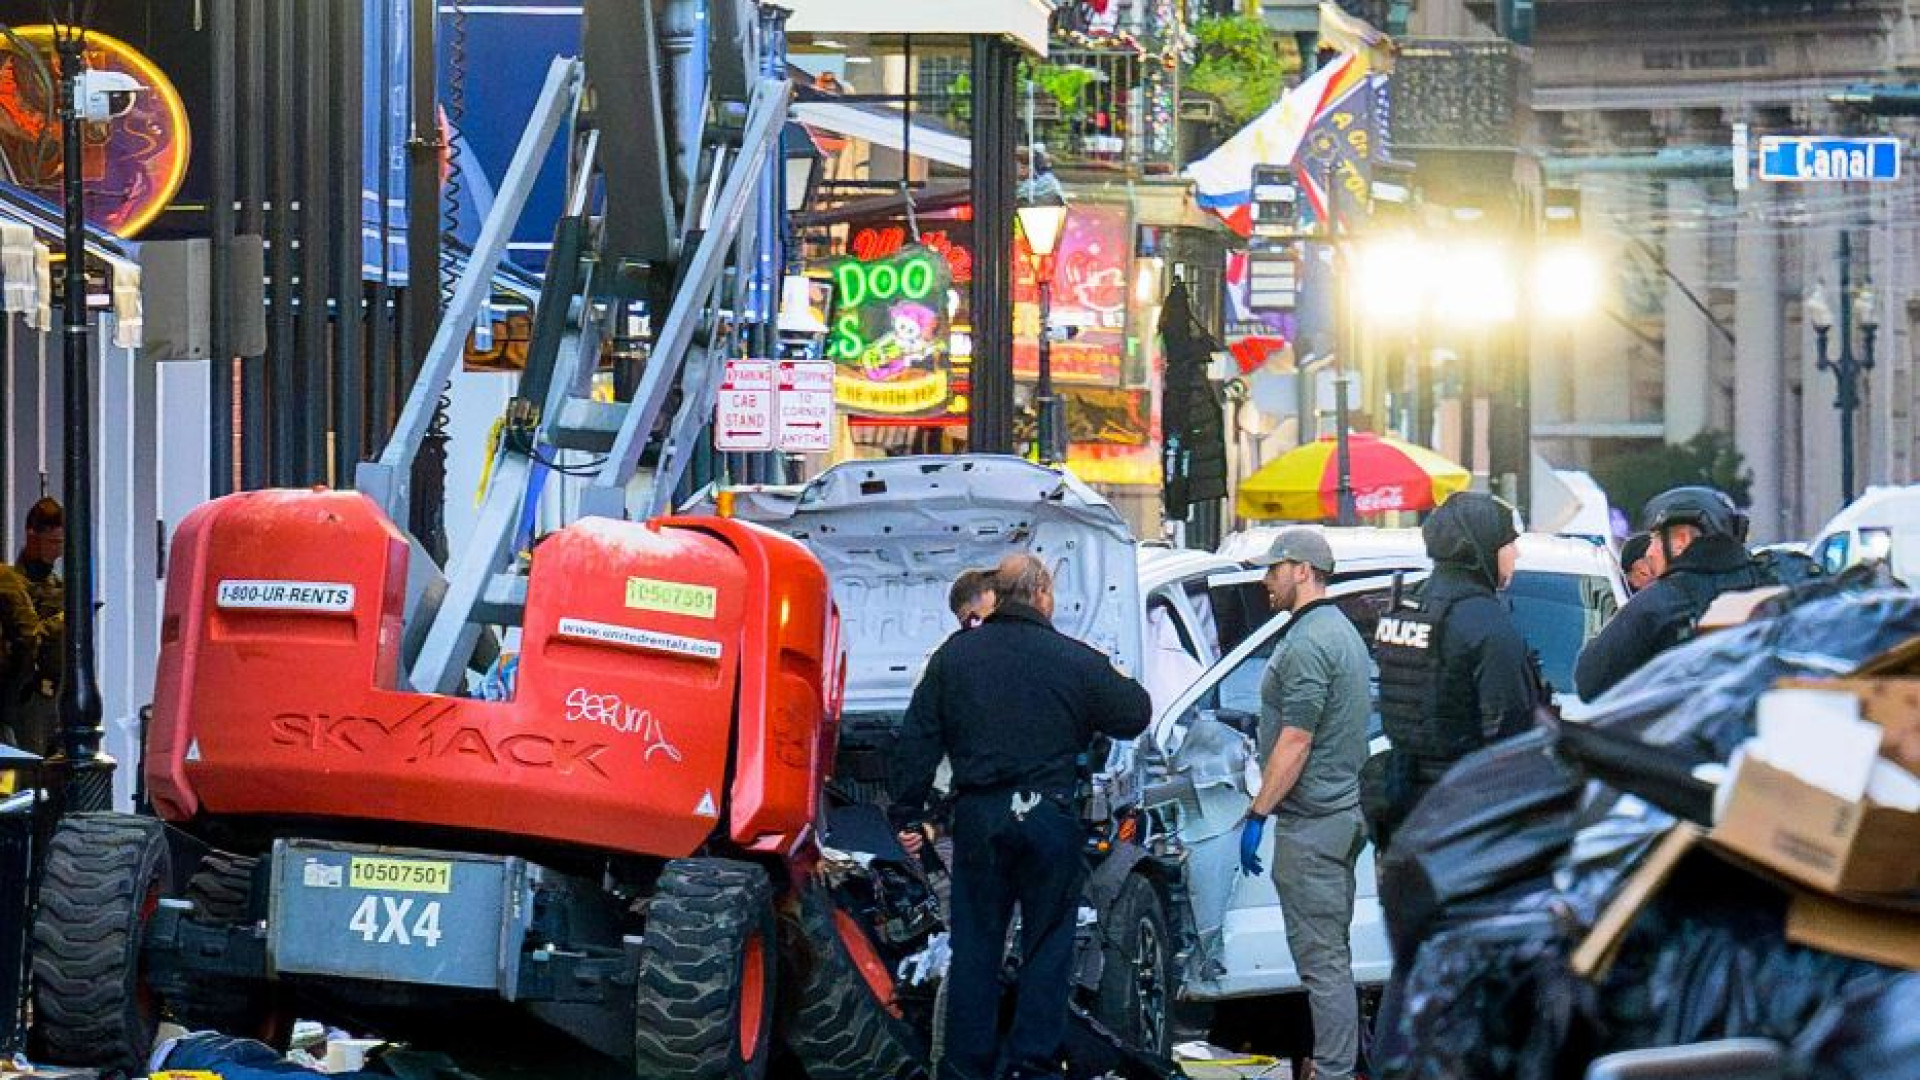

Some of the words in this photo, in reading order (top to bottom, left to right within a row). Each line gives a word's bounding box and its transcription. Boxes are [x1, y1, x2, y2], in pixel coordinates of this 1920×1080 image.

[1796, 143, 1873, 179] Canal
[733, 394, 758, 408] CAB
[783, 406, 827, 417] CORNER
[725, 413, 765, 427] STAND
[781, 433, 829, 446] ANYTIME
[222, 585, 349, 606] 1-800-UR-RENTS
[562, 621, 718, 656] www.unitedrentals.com
[270, 701, 610, 781] SKYJACK
[353, 862, 449, 886] 10507501
[349, 894, 444, 948] 4X4
